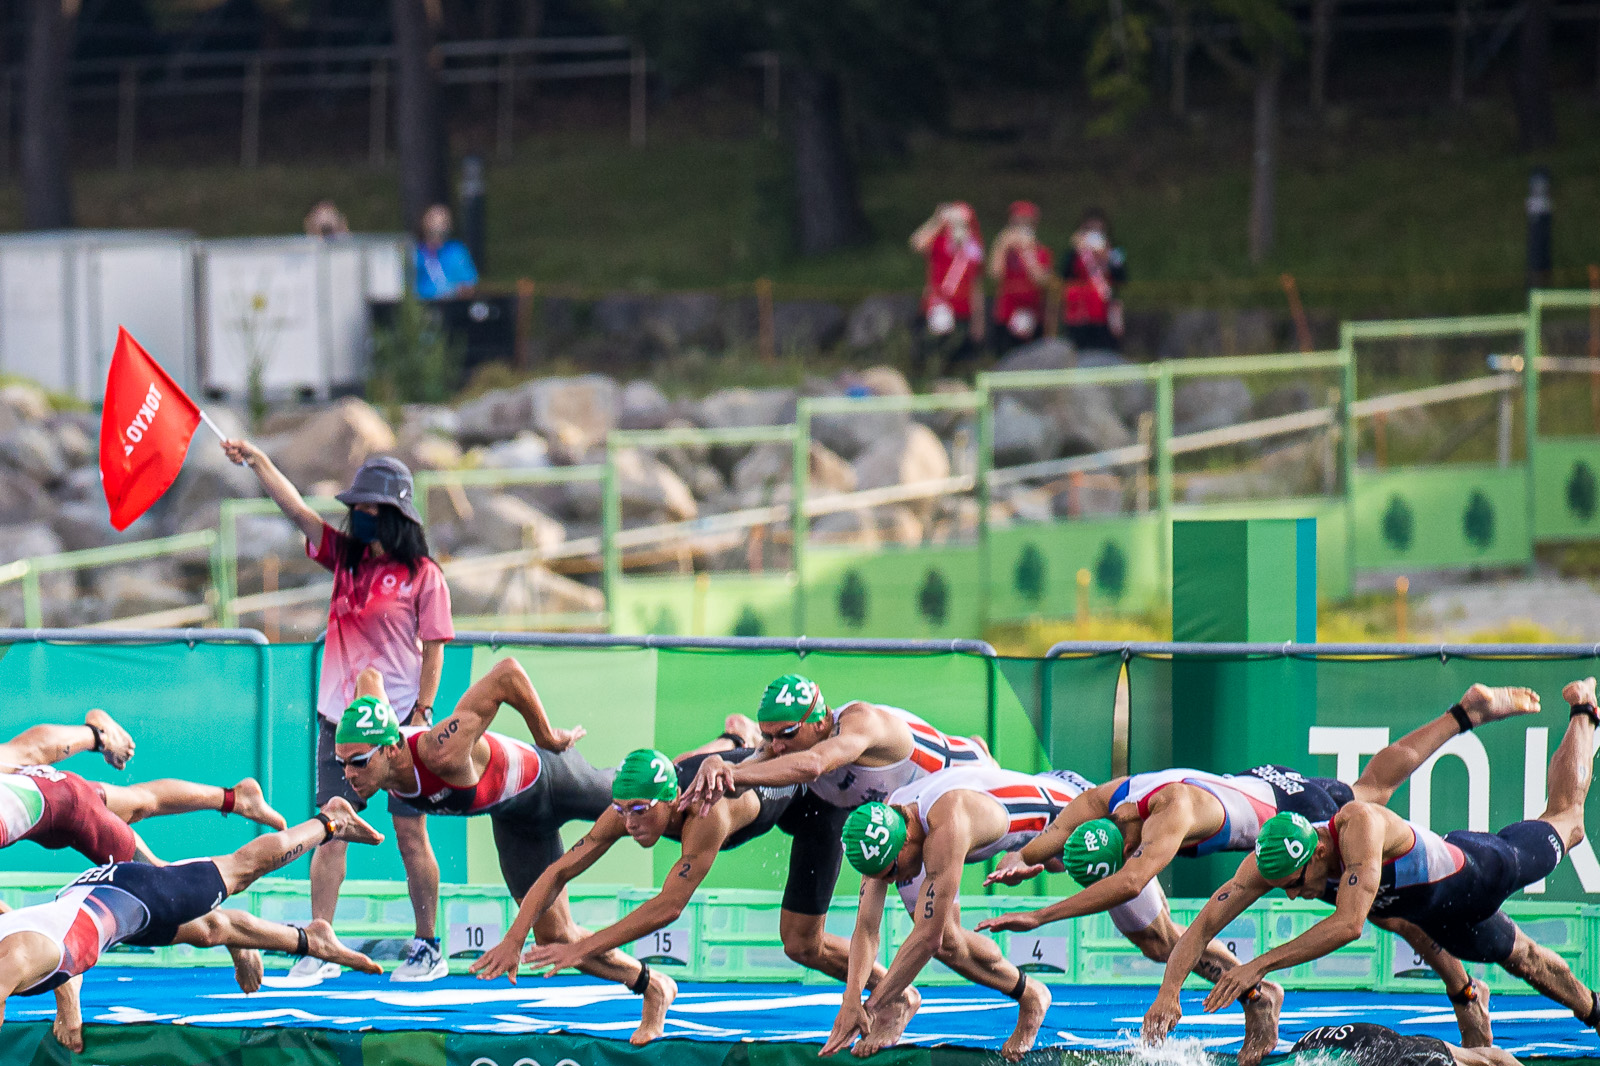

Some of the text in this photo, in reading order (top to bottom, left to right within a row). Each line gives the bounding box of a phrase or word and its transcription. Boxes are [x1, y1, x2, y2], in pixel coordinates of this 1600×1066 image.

[775, 681, 814, 706] 43
[356, 703, 389, 728] 29
[650, 758, 668, 784] 2
[860, 823, 890, 861] 45
[1283, 837, 1304, 859] 6
[678, 863, 692, 879] 2
[466, 926, 484, 947] 10
[654, 932, 672, 953] 15
[1032, 939, 1044, 960] 4
